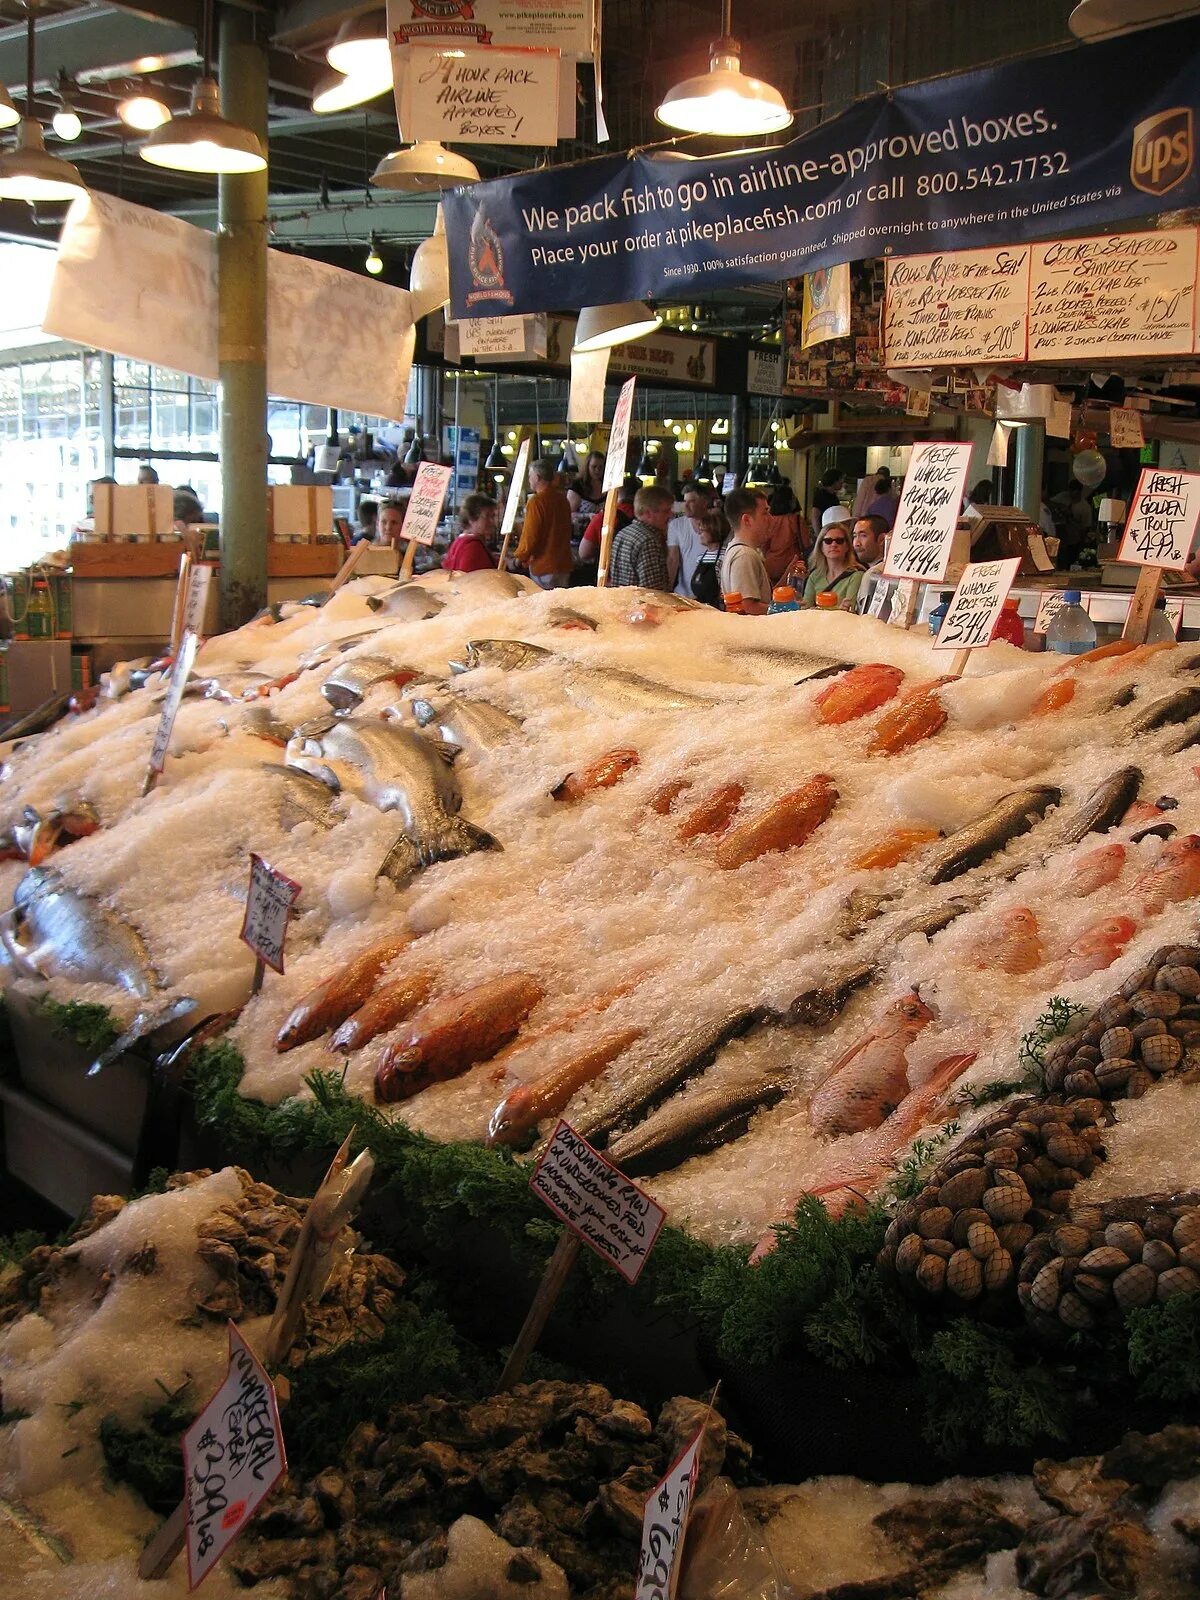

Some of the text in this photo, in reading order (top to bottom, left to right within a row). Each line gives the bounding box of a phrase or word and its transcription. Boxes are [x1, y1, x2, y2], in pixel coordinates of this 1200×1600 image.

[402, 24, 484, 35] WORLD FAMOUS
[455, 67, 491, 84] HOUR
[494, 67, 539, 85] PACK
[436, 85, 508, 105] AIRLINE
[442, 104, 517, 121] APPROVED
[1136, 130, 1188, 184] ups
[522, 107, 1058, 233] We pack fish to go in airline-approved boxes.
[531, 246, 575, 266] Place
[578, 238, 619, 264] your
[624, 229, 662, 252] order
[664, 228, 678, 245] at
[678, 197, 842, 248] pikeplacefish.com
[845, 189, 863, 209] or
[866, 176, 905, 202] call
[915, 150, 1071, 198] 800.542.7732
[663, 266, 682, 277] Since
[682, 263, 702, 276] 1930.
[702, 258, 724, 271] 100%
[724, 251, 779, 268] satisfaction
[831, 225, 867, 246] Shipped
[867, 220, 924, 236] overnight
[927, 219, 939, 231] to
[940, 213, 995, 231] anywhere
[997, 209, 1007, 221] in
[1010, 206, 1030, 219] the
[1031, 195, 1068, 215] United
[1069, 190, 1103, 206] States
[1105, 184, 1122, 197] via
[1043, 236, 1178, 266] COOKED SEAFOOD
[1061, 279, 1090, 296] KING
[1090, 276, 1122, 294] CRAB
[907, 308, 940, 325] JUMBO
[1098, 317, 1131, 331] CRAB
[903, 330, 926, 348] KING
[950, 325, 978, 341] LEGS
[754, 351, 779, 364] FRESH
[645, 366, 669, 377] PRODUCE
[916, 444, 961, 467] FRESH
[913, 463, 962, 485] WHOLE
[1146, 473, 1190, 495] FRESH
[903, 485, 957, 508] ALASKAN
[1140, 493, 1189, 517] GOLDEN
[905, 505, 937, 527] KING
[1136, 516, 1186, 533] TROUT
[900, 526, 951, 546] SALMON
[971, 562, 1004, 579] FRESH
[959, 581, 999, 596] WHOLE
[555, 1128, 650, 1218] CONSUMING RAW
[550, 1145, 646, 1239] OR UNDERCOOKED FOOD
[539, 1161, 583, 1206] INCREASES
[583, 1200, 607, 1227] YOUR
[628, 1243, 647, 1258] OF
